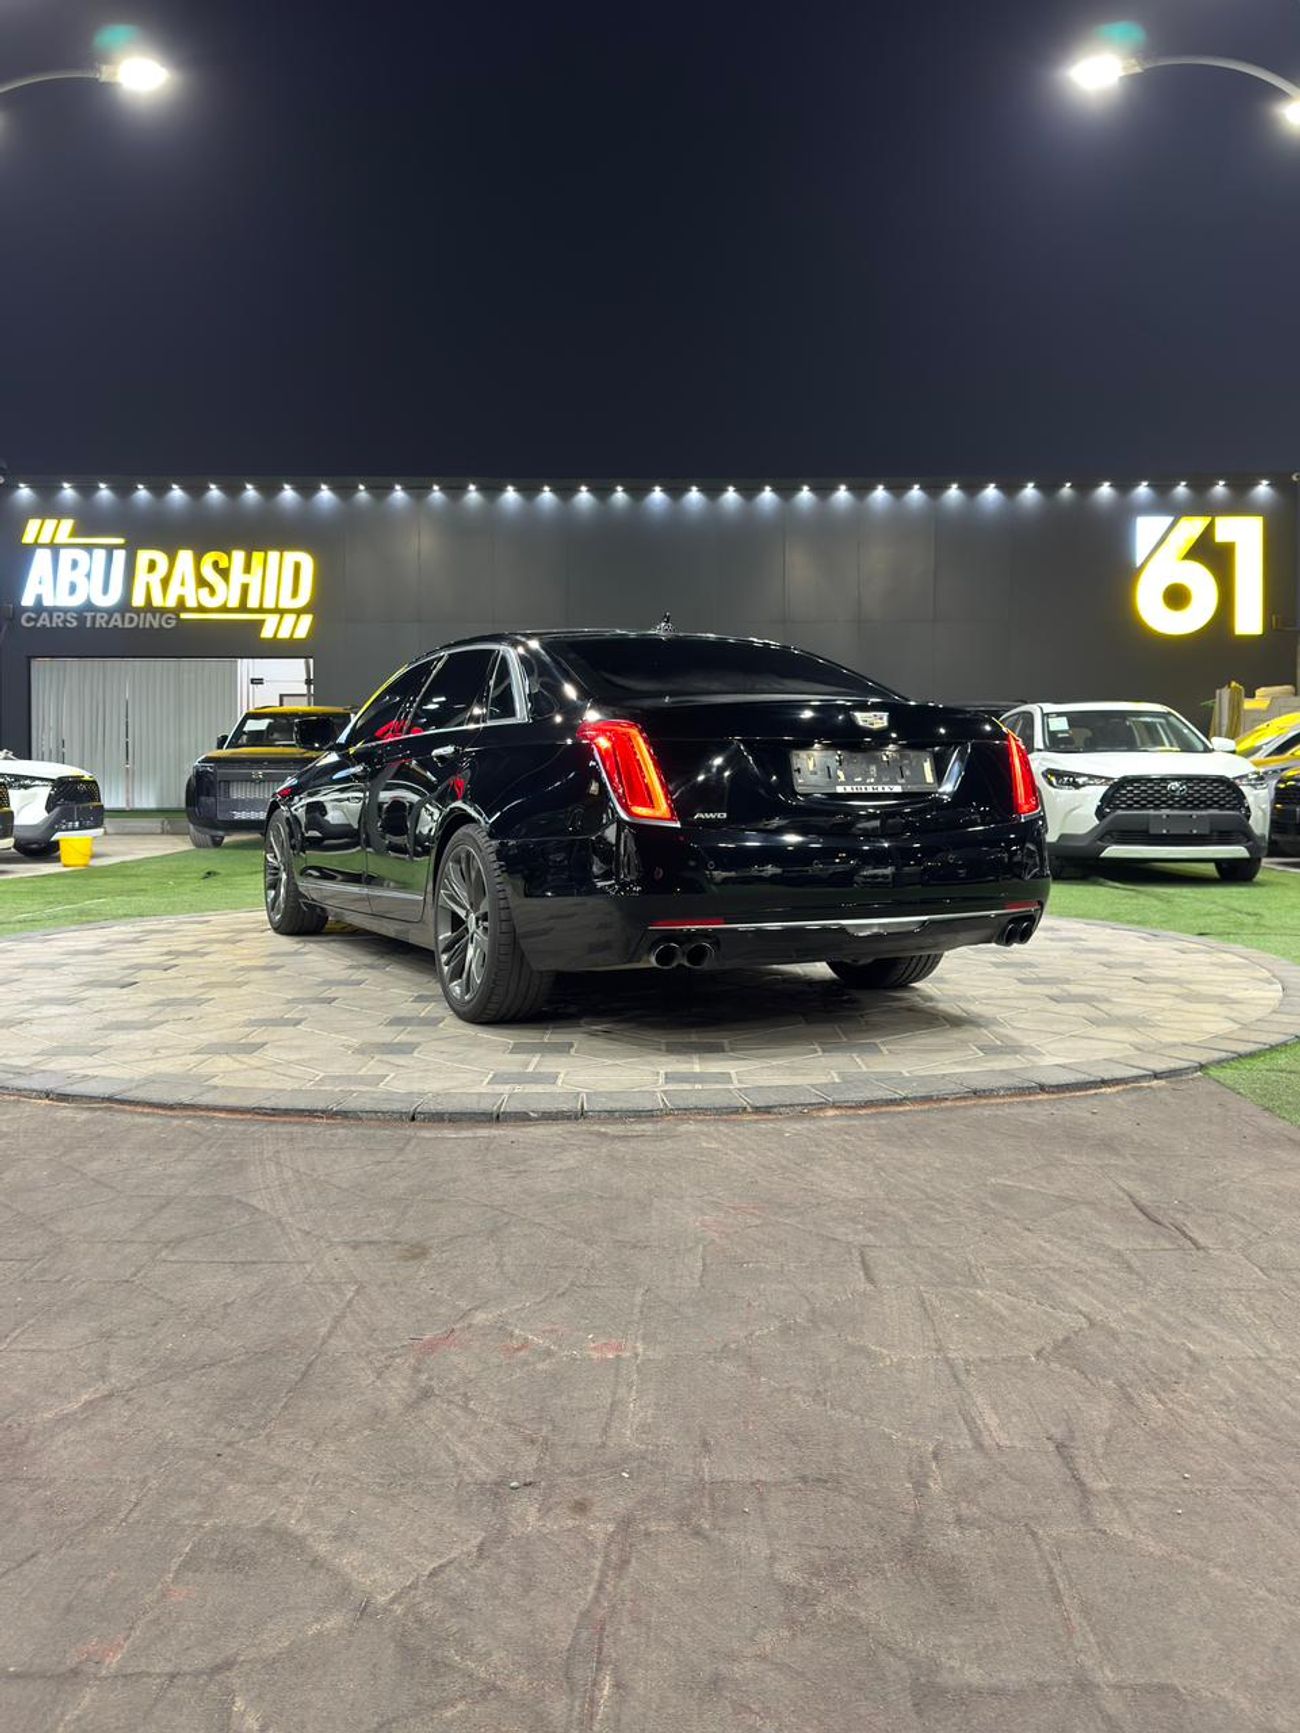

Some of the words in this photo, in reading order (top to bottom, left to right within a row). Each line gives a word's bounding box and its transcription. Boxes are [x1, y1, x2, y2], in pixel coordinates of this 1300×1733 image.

[20, 548, 126, 608] ABU
[131, 549, 315, 610] RASHID
[1135, 515, 1264, 636] 61
[20, 612, 78, 629] CARS
[85, 612, 178, 629] TRADING
[693, 811, 727, 819] AWD
